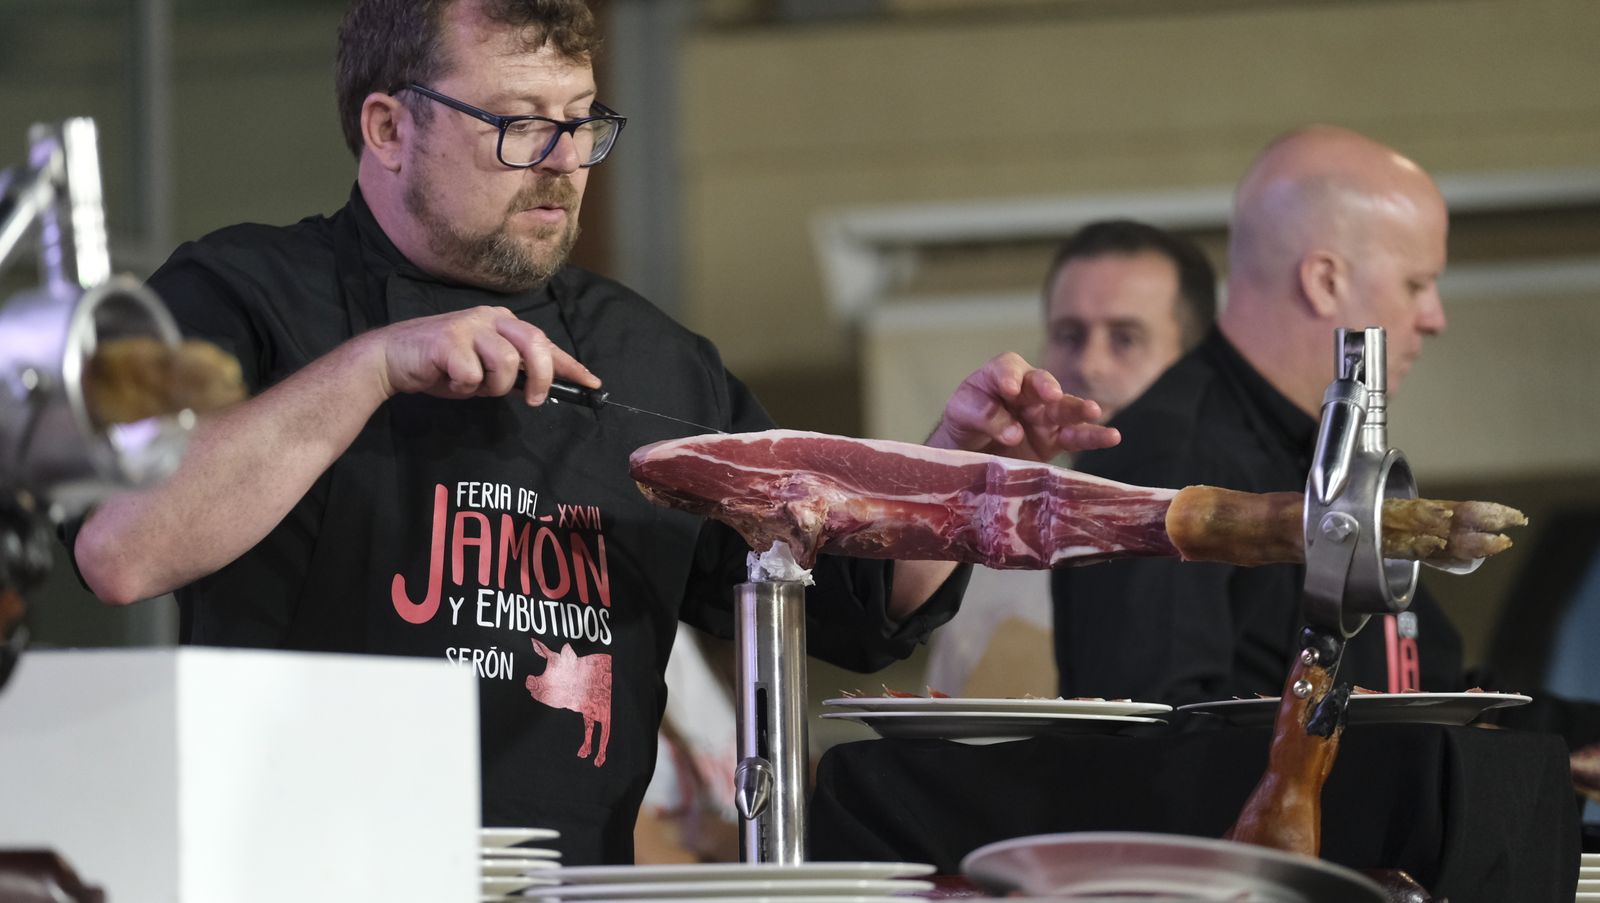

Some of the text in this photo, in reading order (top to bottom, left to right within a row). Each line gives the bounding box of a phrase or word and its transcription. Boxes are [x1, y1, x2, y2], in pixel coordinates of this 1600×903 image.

[456, 481, 538, 519] FERIA DEL
[557, 503, 601, 531] XXVII
[391, 483, 611, 625] JAMÓN
[449, 588, 612, 646] Y EMBUTIDOS
